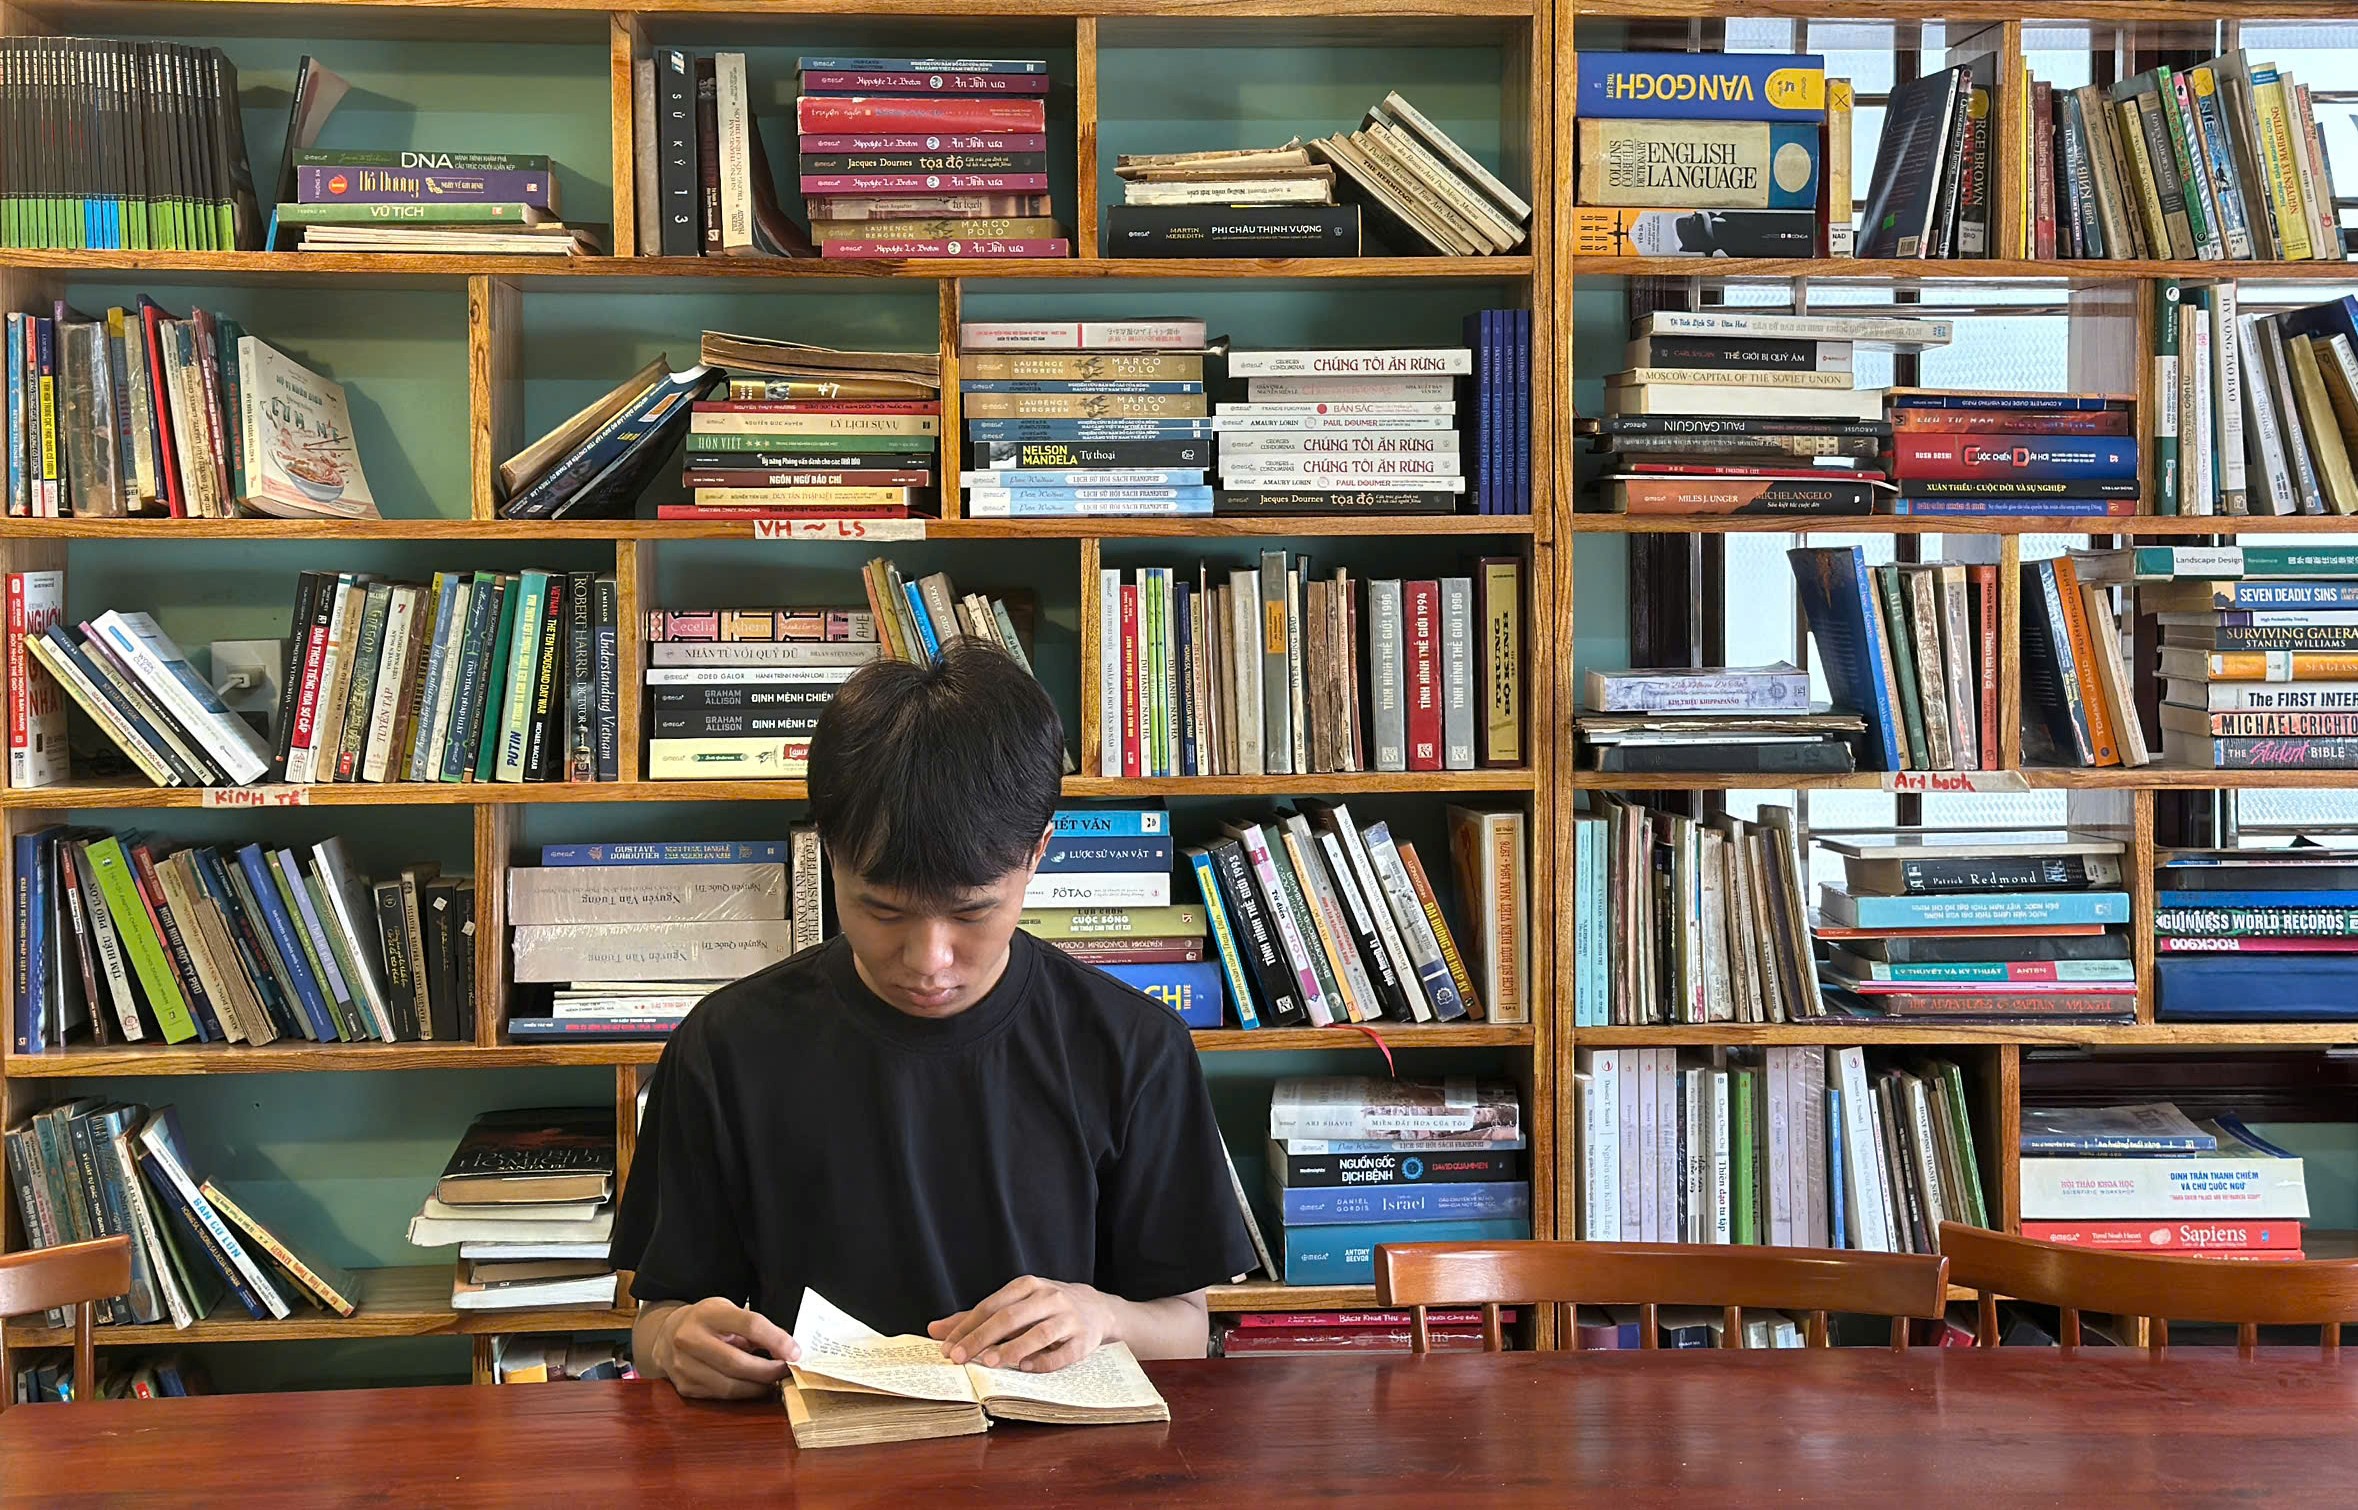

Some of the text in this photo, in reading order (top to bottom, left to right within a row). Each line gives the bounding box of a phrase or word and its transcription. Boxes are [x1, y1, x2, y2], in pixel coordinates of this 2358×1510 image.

[401, 152, 453, 169] DNA
[1646, 142, 1737, 165] ENGLISH
[848, 158, 877, 169] Jacques
[880, 158, 913, 167] Dournes
[1609, 140, 1621, 186] COLLINS
[1636, 141, 1646, 188] DICTIONARY
[1647, 167, 1757, 190] LANGUAGE
[1973, 153, 1984, 206] BROWN
[1166, 232, 1204, 240] MEREDITH
[1211, 226, 1228, 234] PHI
[1229, 225, 1256, 234] CHÂU
[1256, 226, 1288, 235] THỊNH
[1112, 358, 1161, 366] MARCO
[1118, 365, 1155, 374] POLO
[1313, 355, 1359, 371] CHÚNG
[1362, 355, 1385, 371] TÔI
[1388, 355, 1407, 371] ĂN
[1734, 372, 1748, 382] OF
[1750, 371, 1769, 382] THE
[1772, 372, 1807, 383] SOVIET
[1808, 373, 1841, 383] UNION
[1323, 419, 1341, 427] PAUL
[1342, 419, 1378, 427] DOUMER
[1665, 420, 1745, 432] PAUL GAUGUIN
[1022, 445, 1068, 456] NELSON
[1093, 451, 1116, 461] thoại
[1022, 455, 1078, 466] MANDELA
[1678, 495, 1702, 503] MILES
[1710, 495, 1738, 503] UNGER
[1756, 491, 1832, 501] MICHELANGELO
[758, 521, 792, 537] VH
[838, 521, 866, 537] LS
[2175, 556, 2243, 566] Landscape Design
[551, 585, 561, 615] VIETNAM
[2240, 588, 2337, 602] SEVEN DEADLY SINS
[1417, 592, 1428, 615] 1994
[550, 619, 558, 631] THE
[670, 620, 715, 632] Cecelia
[548, 631, 556, 646] TEN
[2226, 628, 2304, 639] SURVIVING
[574, 577, 588, 723] ROBERT HARRIS DICTATOR
[2246, 639, 2346, 648] STANLEY WILLIAMS
[540, 646, 554, 686] THOUSAND
[598, 631, 615, 711] Understanding
[750, 693, 775, 703] ĐỊNH
[2248, 693, 2273, 707] The
[2277, 693, 2317, 707] FIRST
[537, 701, 546, 714] WAR
[2222, 715, 2296, 735] MICHAEL
[601, 716, 615, 760] Vietnam
[507, 730, 522, 766] PUTIN
[2228, 740, 2345, 765] THE Student BIBLE
[1895, 773, 1925, 789] Art
[1050, 816, 1112, 831] IẾT VĂN
[1933, 870, 2037, 886] Patrick Redmond
[2164, 913, 2344, 931] GUINNESS WORLD RECORDS
[2170, 938, 2240, 950] ROCK900
[1339, 1154, 1396, 1170] NGUỒN GỐC
[1342, 1168, 1393, 1184] DỊCH BỆNH
[1383, 1196, 1425, 1211] Israel
[2179, 1225, 2247, 1249] Sapiens
